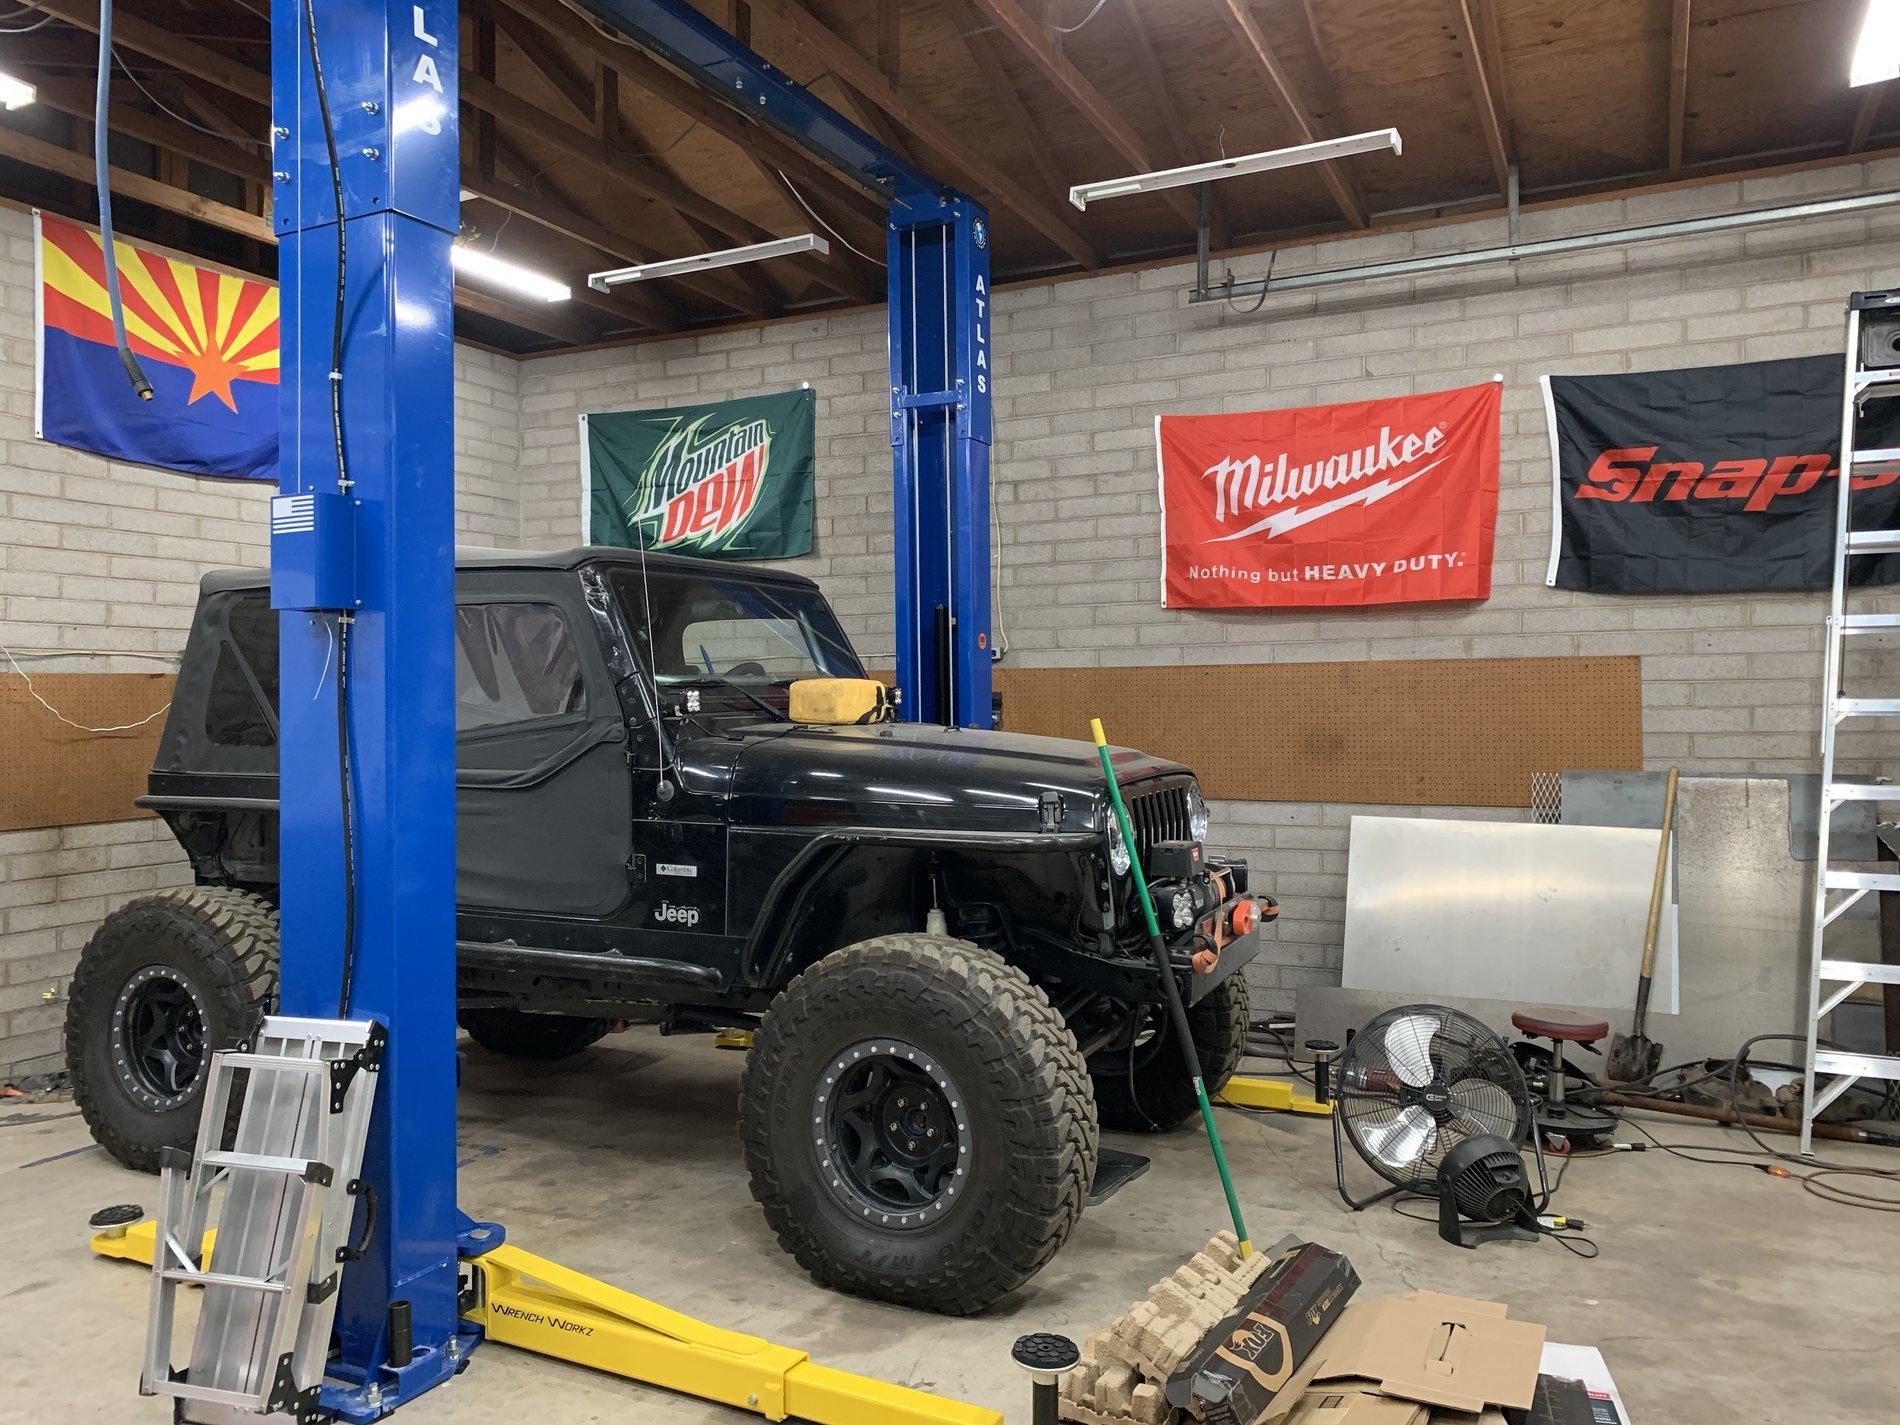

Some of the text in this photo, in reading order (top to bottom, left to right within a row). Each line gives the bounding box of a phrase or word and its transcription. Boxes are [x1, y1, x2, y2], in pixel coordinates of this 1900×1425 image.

[975, 274, 987, 394] ATLAS
[643, 422, 765, 515] Mountain
[1189, 551, 1464, 583] Nothing but HEAVY DUTY.
[654, 902, 699, 927] Jeep
[491, 1302, 594, 1337] WRENCH WORKZ
[1245, 1322, 1275, 1361] FOX
